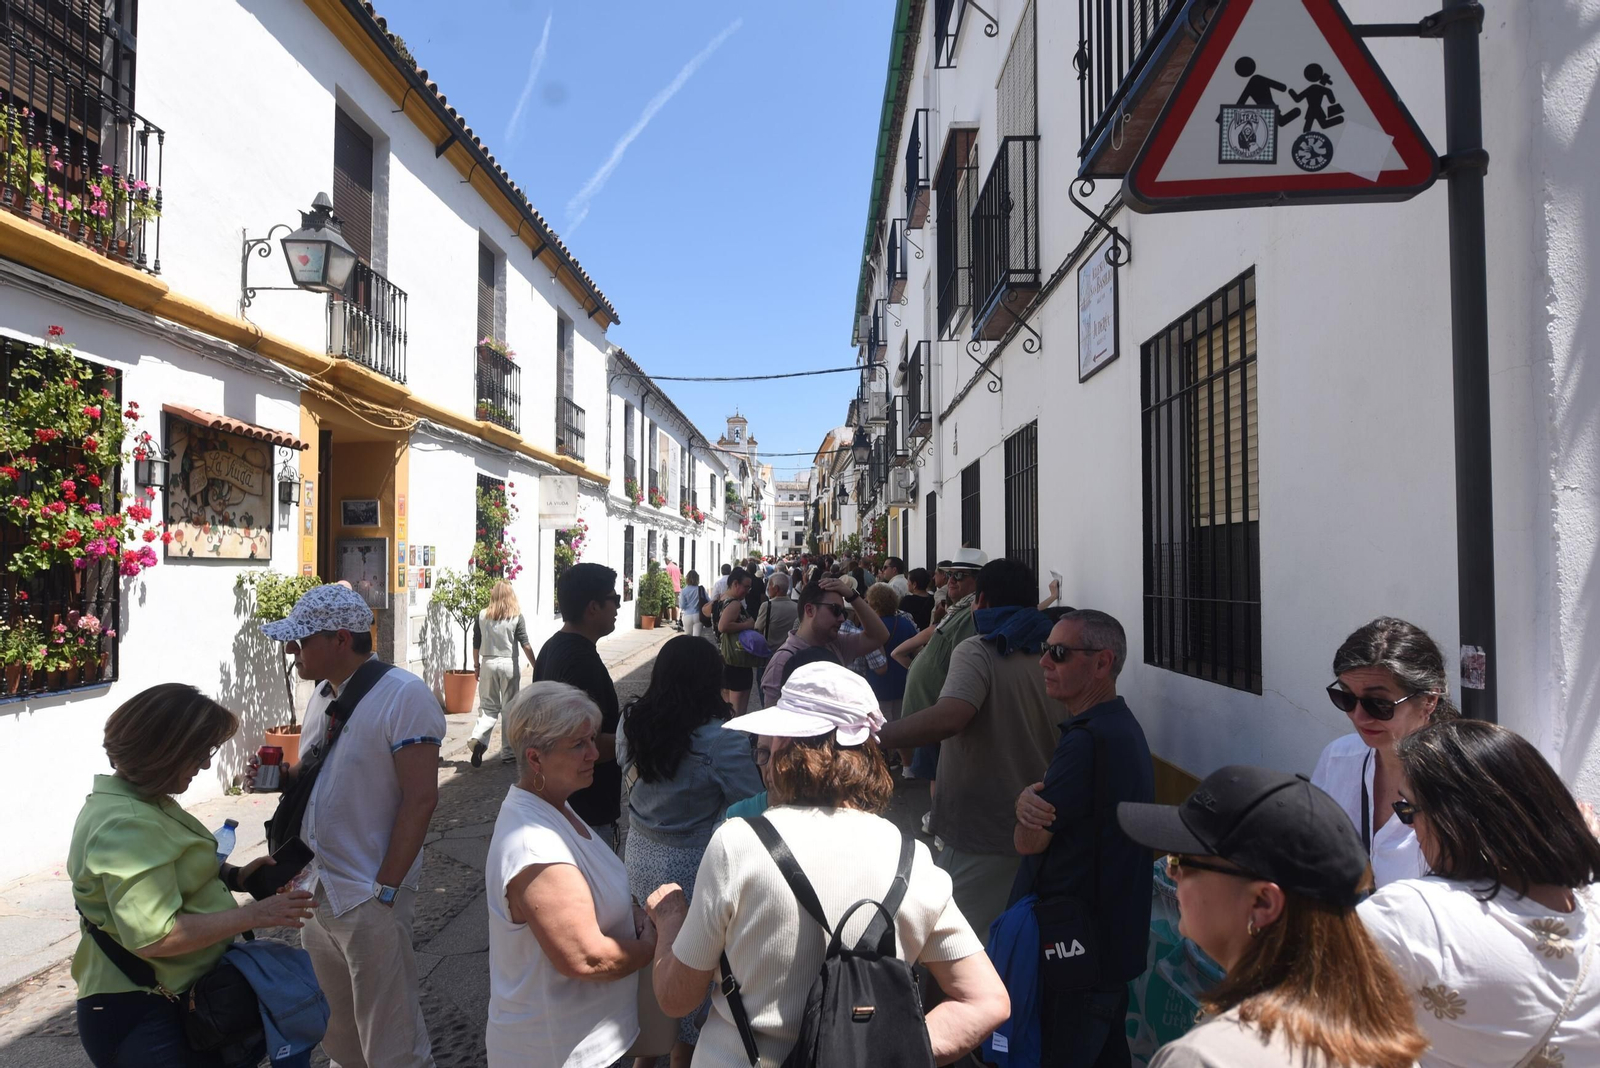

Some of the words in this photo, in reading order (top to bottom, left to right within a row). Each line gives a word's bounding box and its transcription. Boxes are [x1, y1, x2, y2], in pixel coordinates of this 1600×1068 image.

[206, 451, 222, 477] La
[221, 455, 254, 488] Viuda
[1044, 938, 1086, 961] FILA
